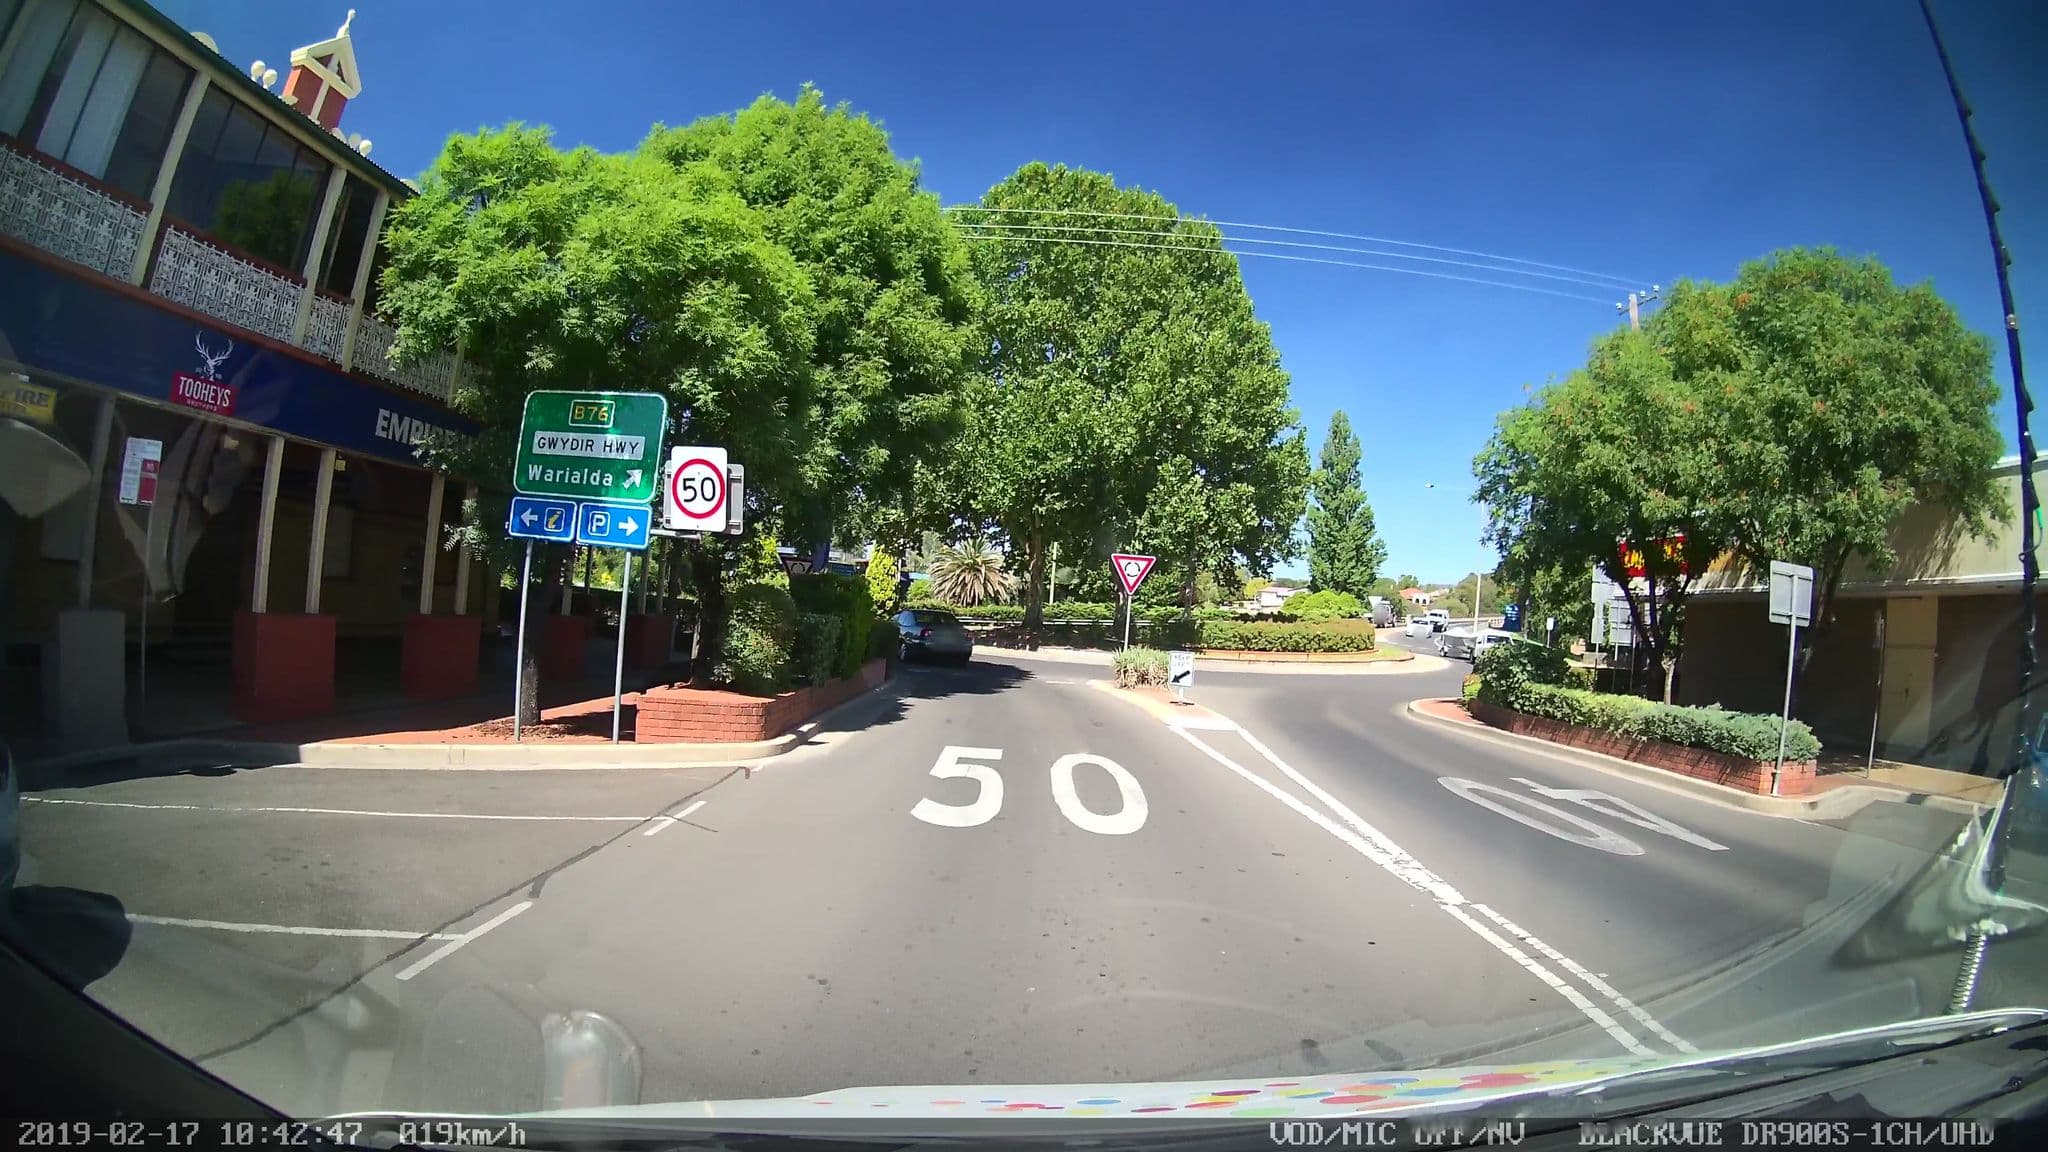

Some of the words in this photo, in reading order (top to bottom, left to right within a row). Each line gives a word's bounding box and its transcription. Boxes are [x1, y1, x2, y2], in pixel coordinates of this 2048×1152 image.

[179, 376, 231, 407] TOOHEYS
[574, 405, 608, 422] B76
[538, 437, 594, 452] GWYDIR
[603, 439, 640, 455] HWY
[528, 464, 613, 487] Warialda
[683, 477, 716, 503] 50
